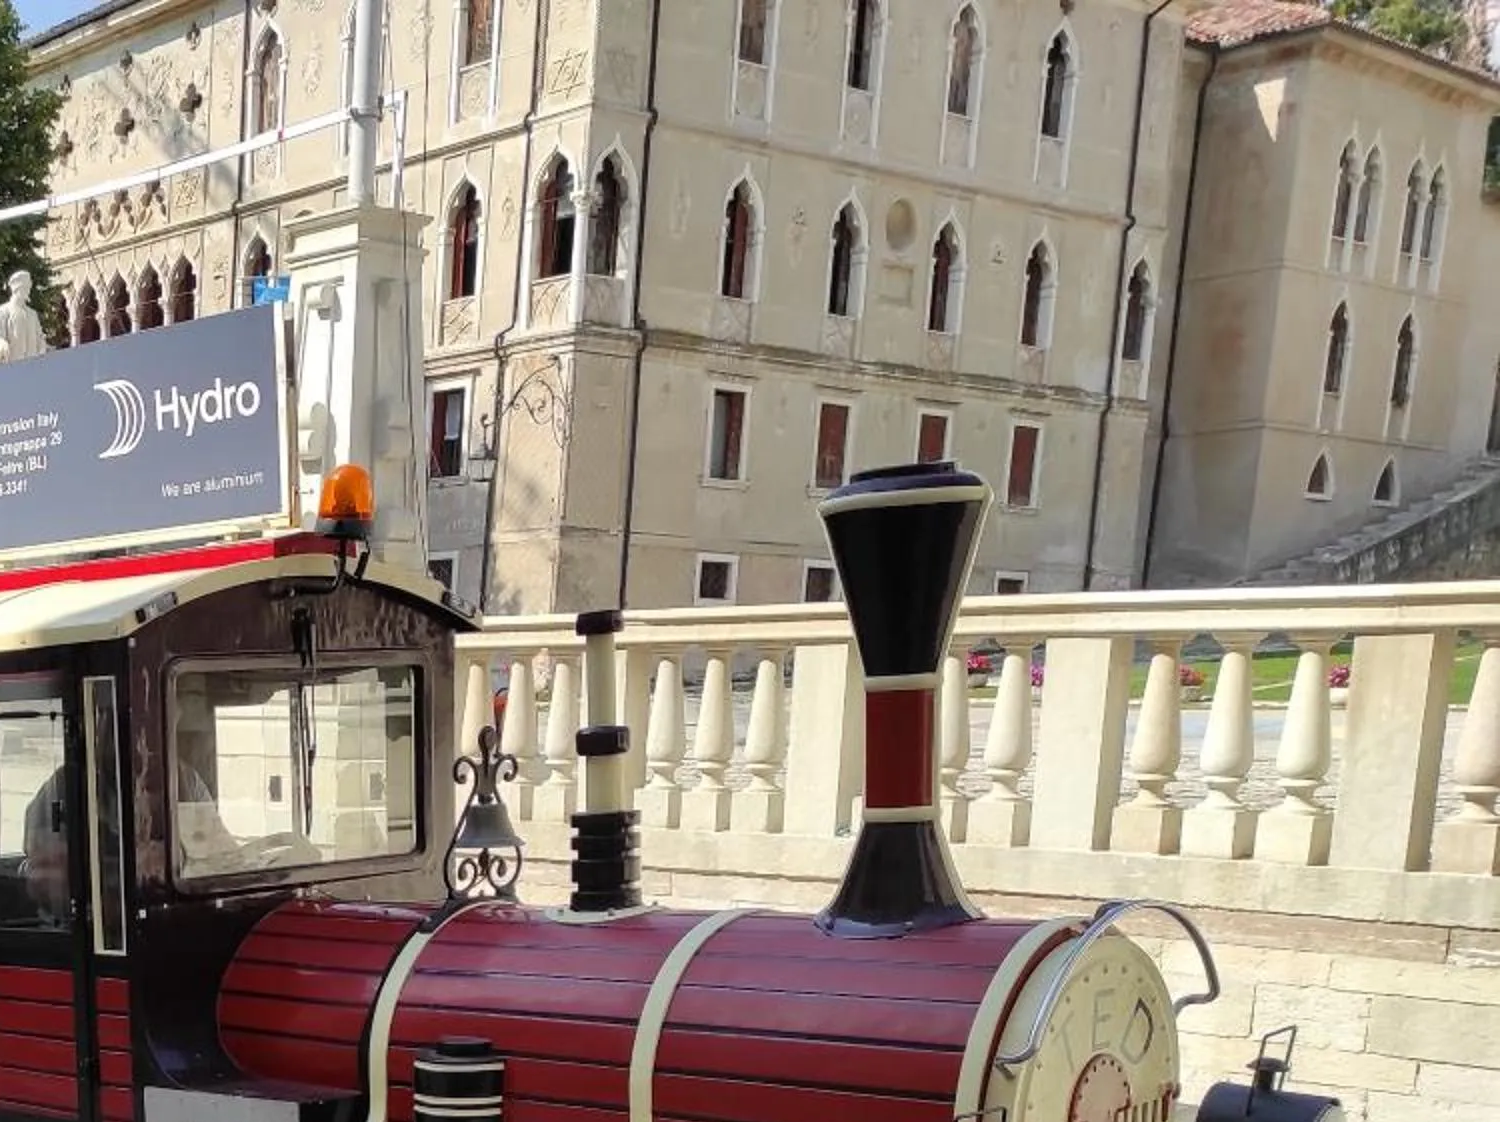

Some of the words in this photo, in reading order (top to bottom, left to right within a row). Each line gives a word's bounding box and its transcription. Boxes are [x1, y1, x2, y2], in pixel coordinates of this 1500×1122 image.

[37, 411, 59, 429] Italy
[154, 377, 261, 437] Hydro
[50, 430, 62, 445] 29
[161, 482, 179, 497] We
[183, 481, 201, 495] are
[203, 471, 264, 491] aluminium
[1053, 986, 1154, 1071] TED
